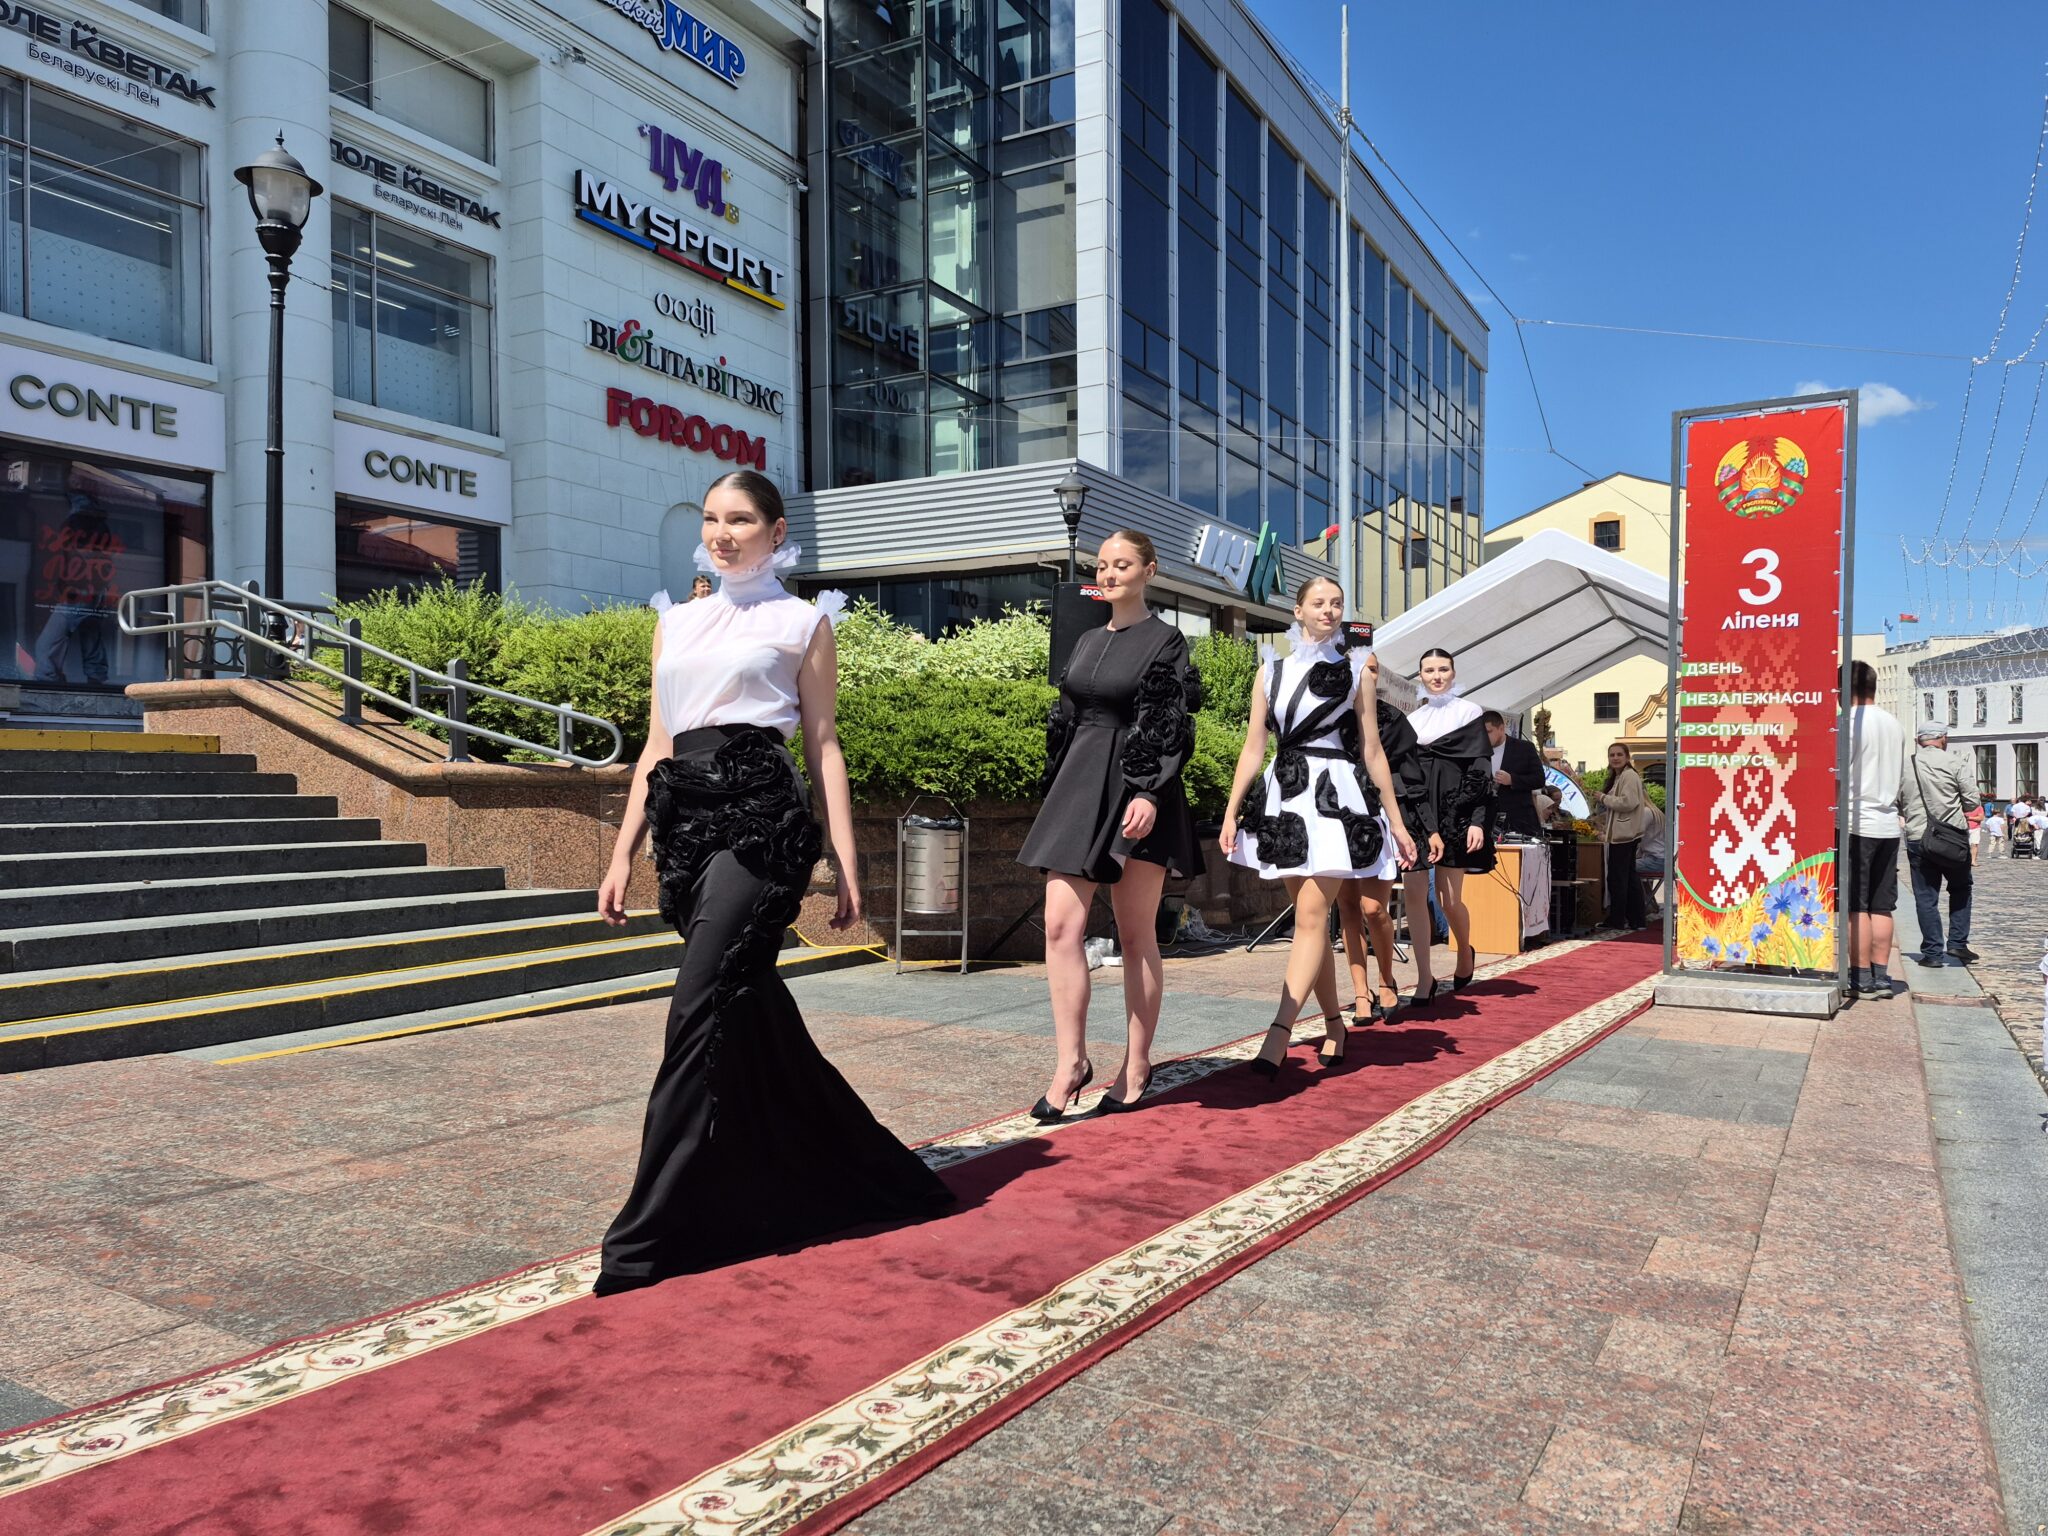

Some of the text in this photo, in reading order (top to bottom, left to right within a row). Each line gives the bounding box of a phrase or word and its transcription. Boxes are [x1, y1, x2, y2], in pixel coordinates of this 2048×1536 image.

[70, 21, 216, 108] КВЕТАК
[661, 0, 746, 86] МИР
[403, 165, 501, 229] КВЕТАК
[655, 291, 718, 338] oodji
[10, 374, 179, 438] CONTE
[607, 387, 767, 471] FOROOM
[364, 450, 478, 498] CONTE
[1738, 548, 1782, 605] 3
[1721, 611, 1799, 629] ліпеня
[1685, 662, 1743, 677] ДЗЕНЬ
[1686, 692, 1823, 706] НЕЗАЛЕЖНАСЦІ
[1685, 724, 1784, 736] РЭСПУБЛІКІ
[1685, 754, 1776, 767] БЕЛАРУСЬ
